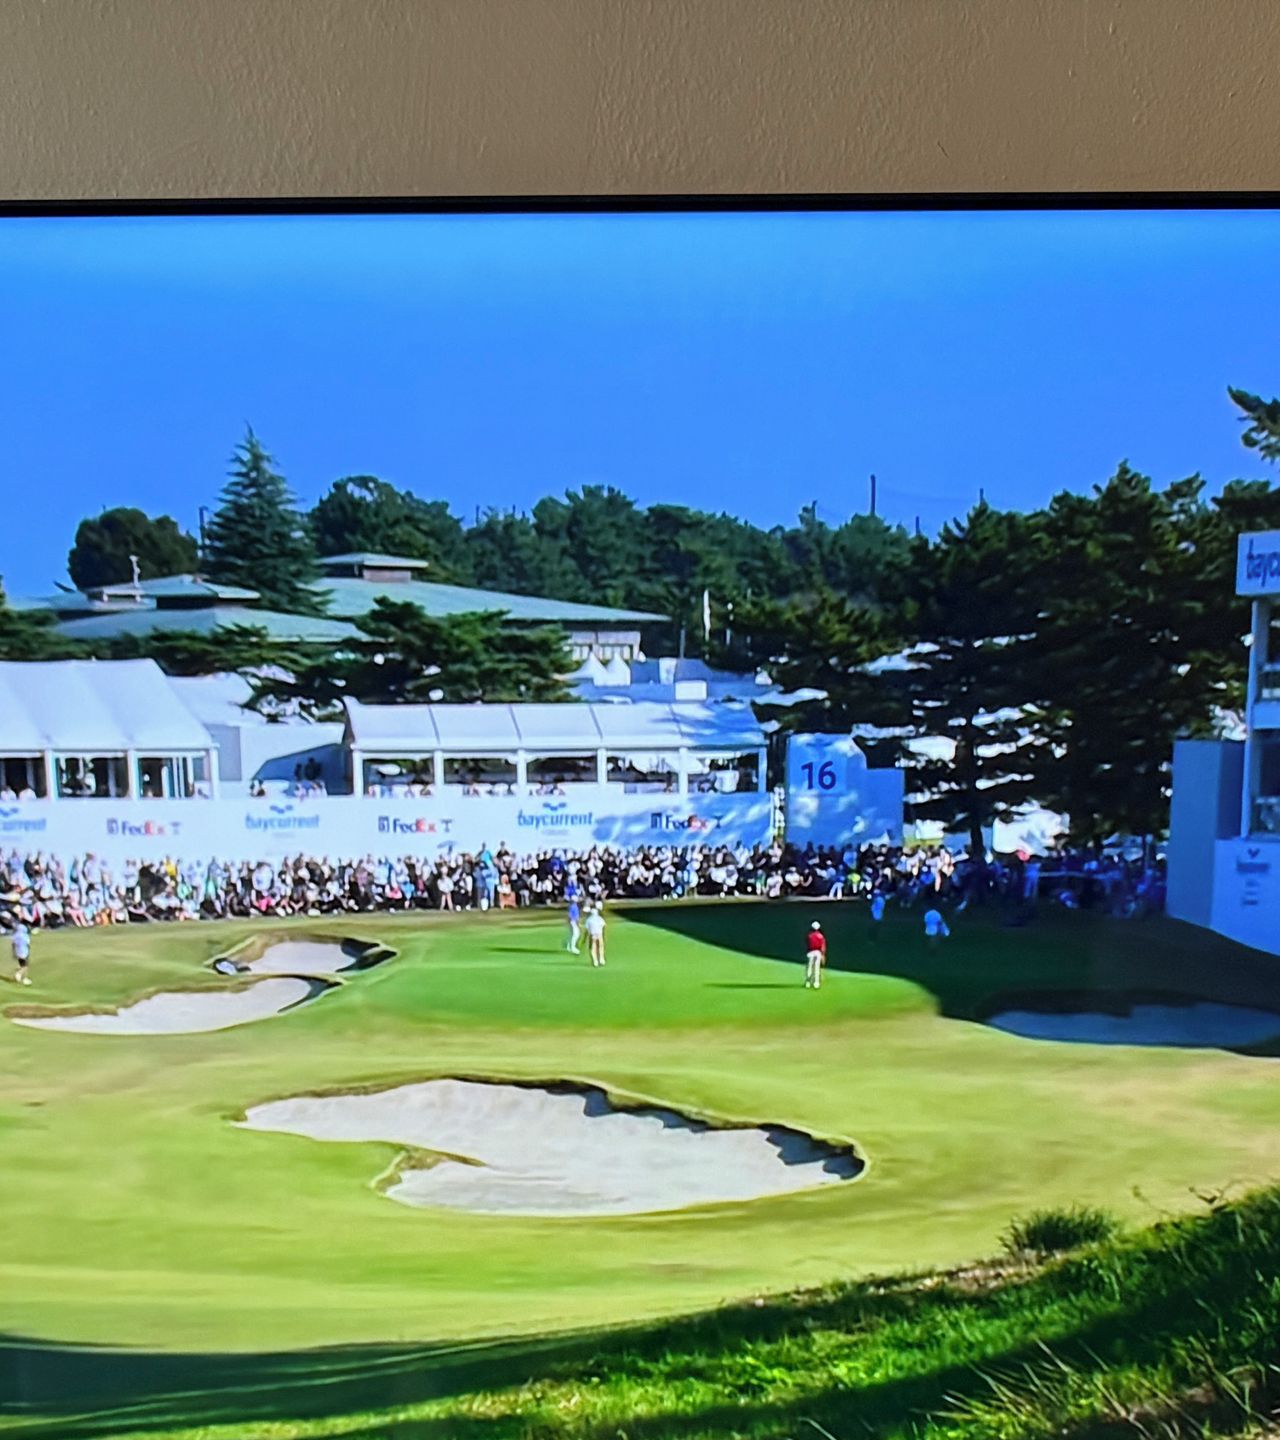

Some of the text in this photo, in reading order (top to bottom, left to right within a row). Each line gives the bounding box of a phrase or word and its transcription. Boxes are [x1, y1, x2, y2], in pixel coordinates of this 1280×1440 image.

[801, 761, 836, 790] 16
[393, 818, 437, 833] FedEx
[517, 809, 593, 829] baycurrent
